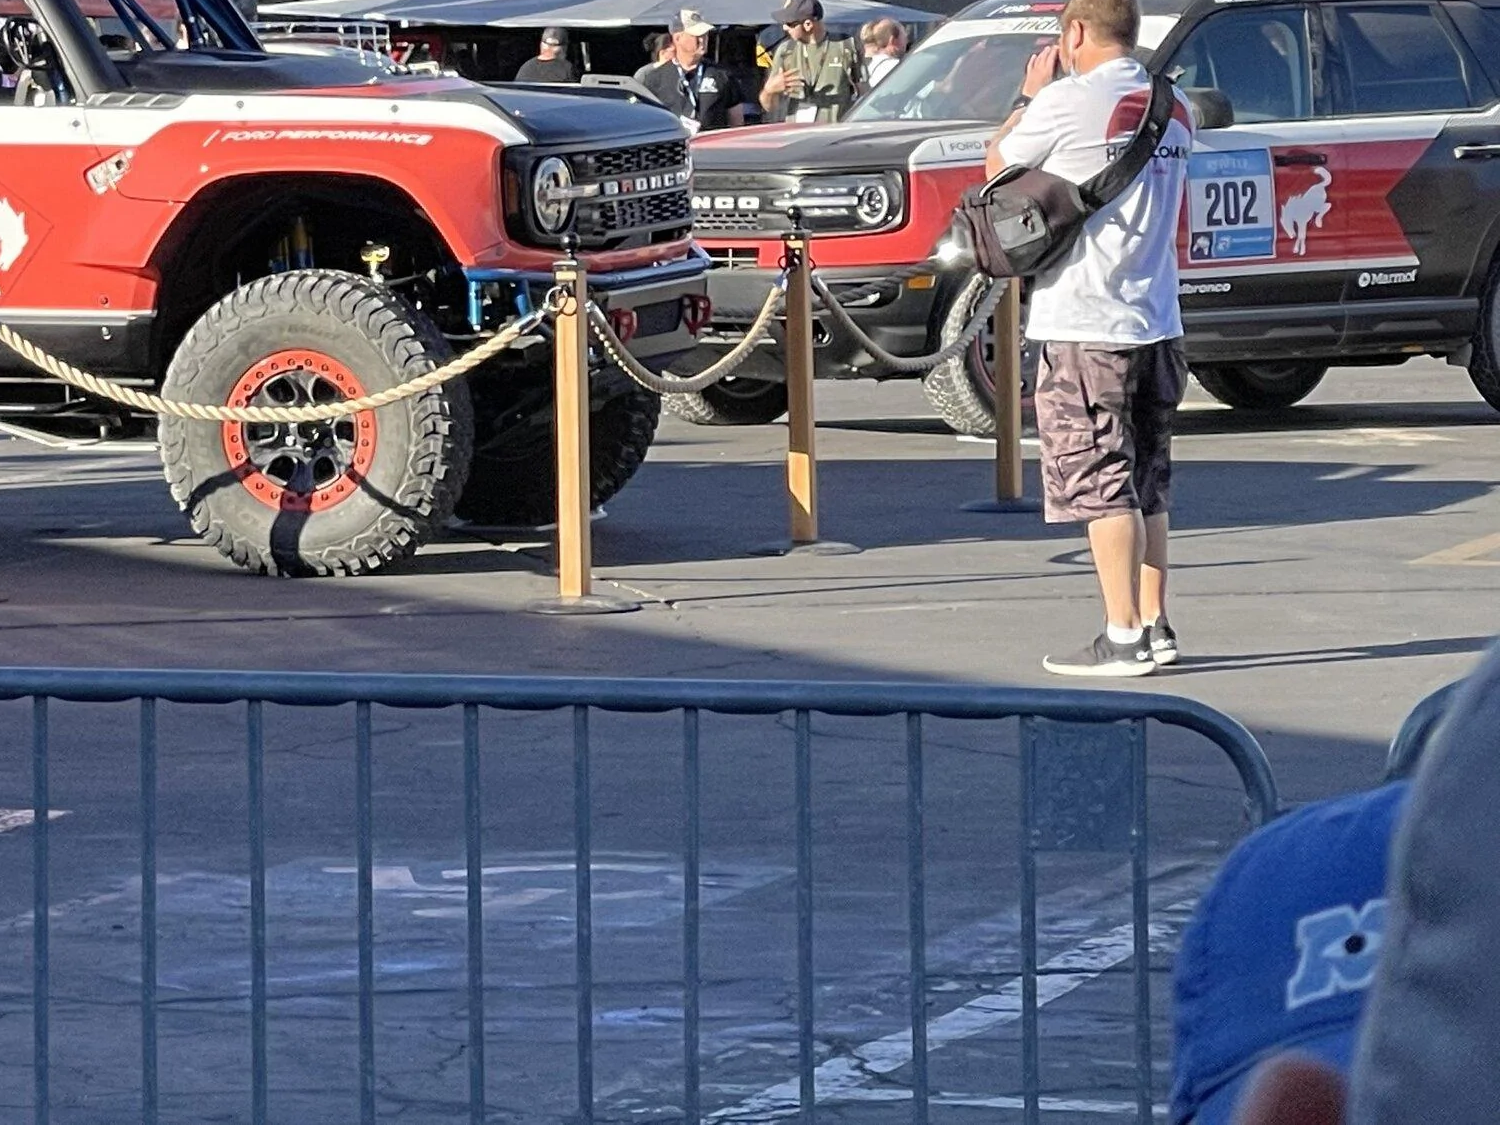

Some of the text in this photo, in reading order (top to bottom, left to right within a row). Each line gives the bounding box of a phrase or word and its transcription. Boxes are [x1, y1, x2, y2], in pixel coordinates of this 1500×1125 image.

[221, 130, 434, 146] FORD PERFORMANCE
[950, 141, 983, 152] FORD
[603, 171, 689, 195] BRONCO
[691, 196, 760, 210] NCO
[1205, 180, 1259, 226] 202
